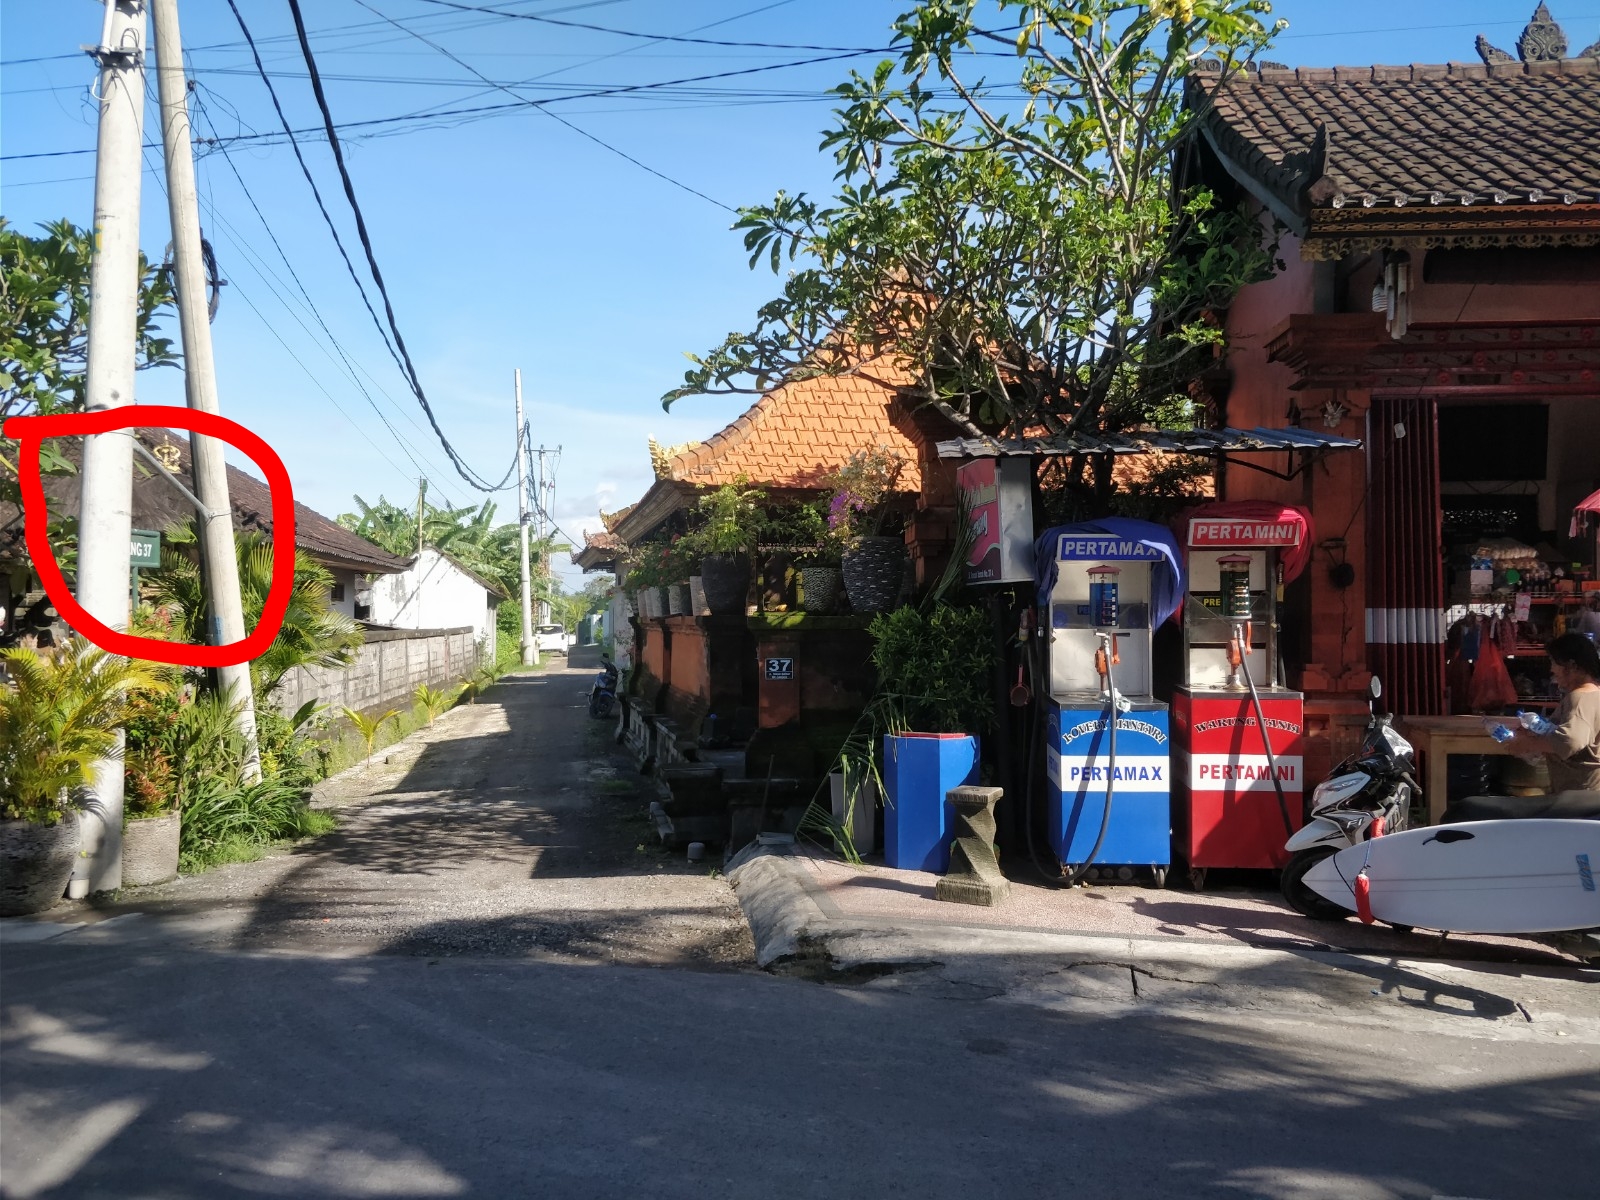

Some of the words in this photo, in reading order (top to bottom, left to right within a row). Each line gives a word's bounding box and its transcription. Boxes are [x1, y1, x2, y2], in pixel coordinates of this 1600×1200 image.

[1196, 525, 1294, 539] PERTAMINI
[143, 543, 153, 558] 37
[768, 659, 791, 672] 37
[1194, 717, 1256, 733] WARUNG
[1199, 764, 1295, 781] PERTAMNI
